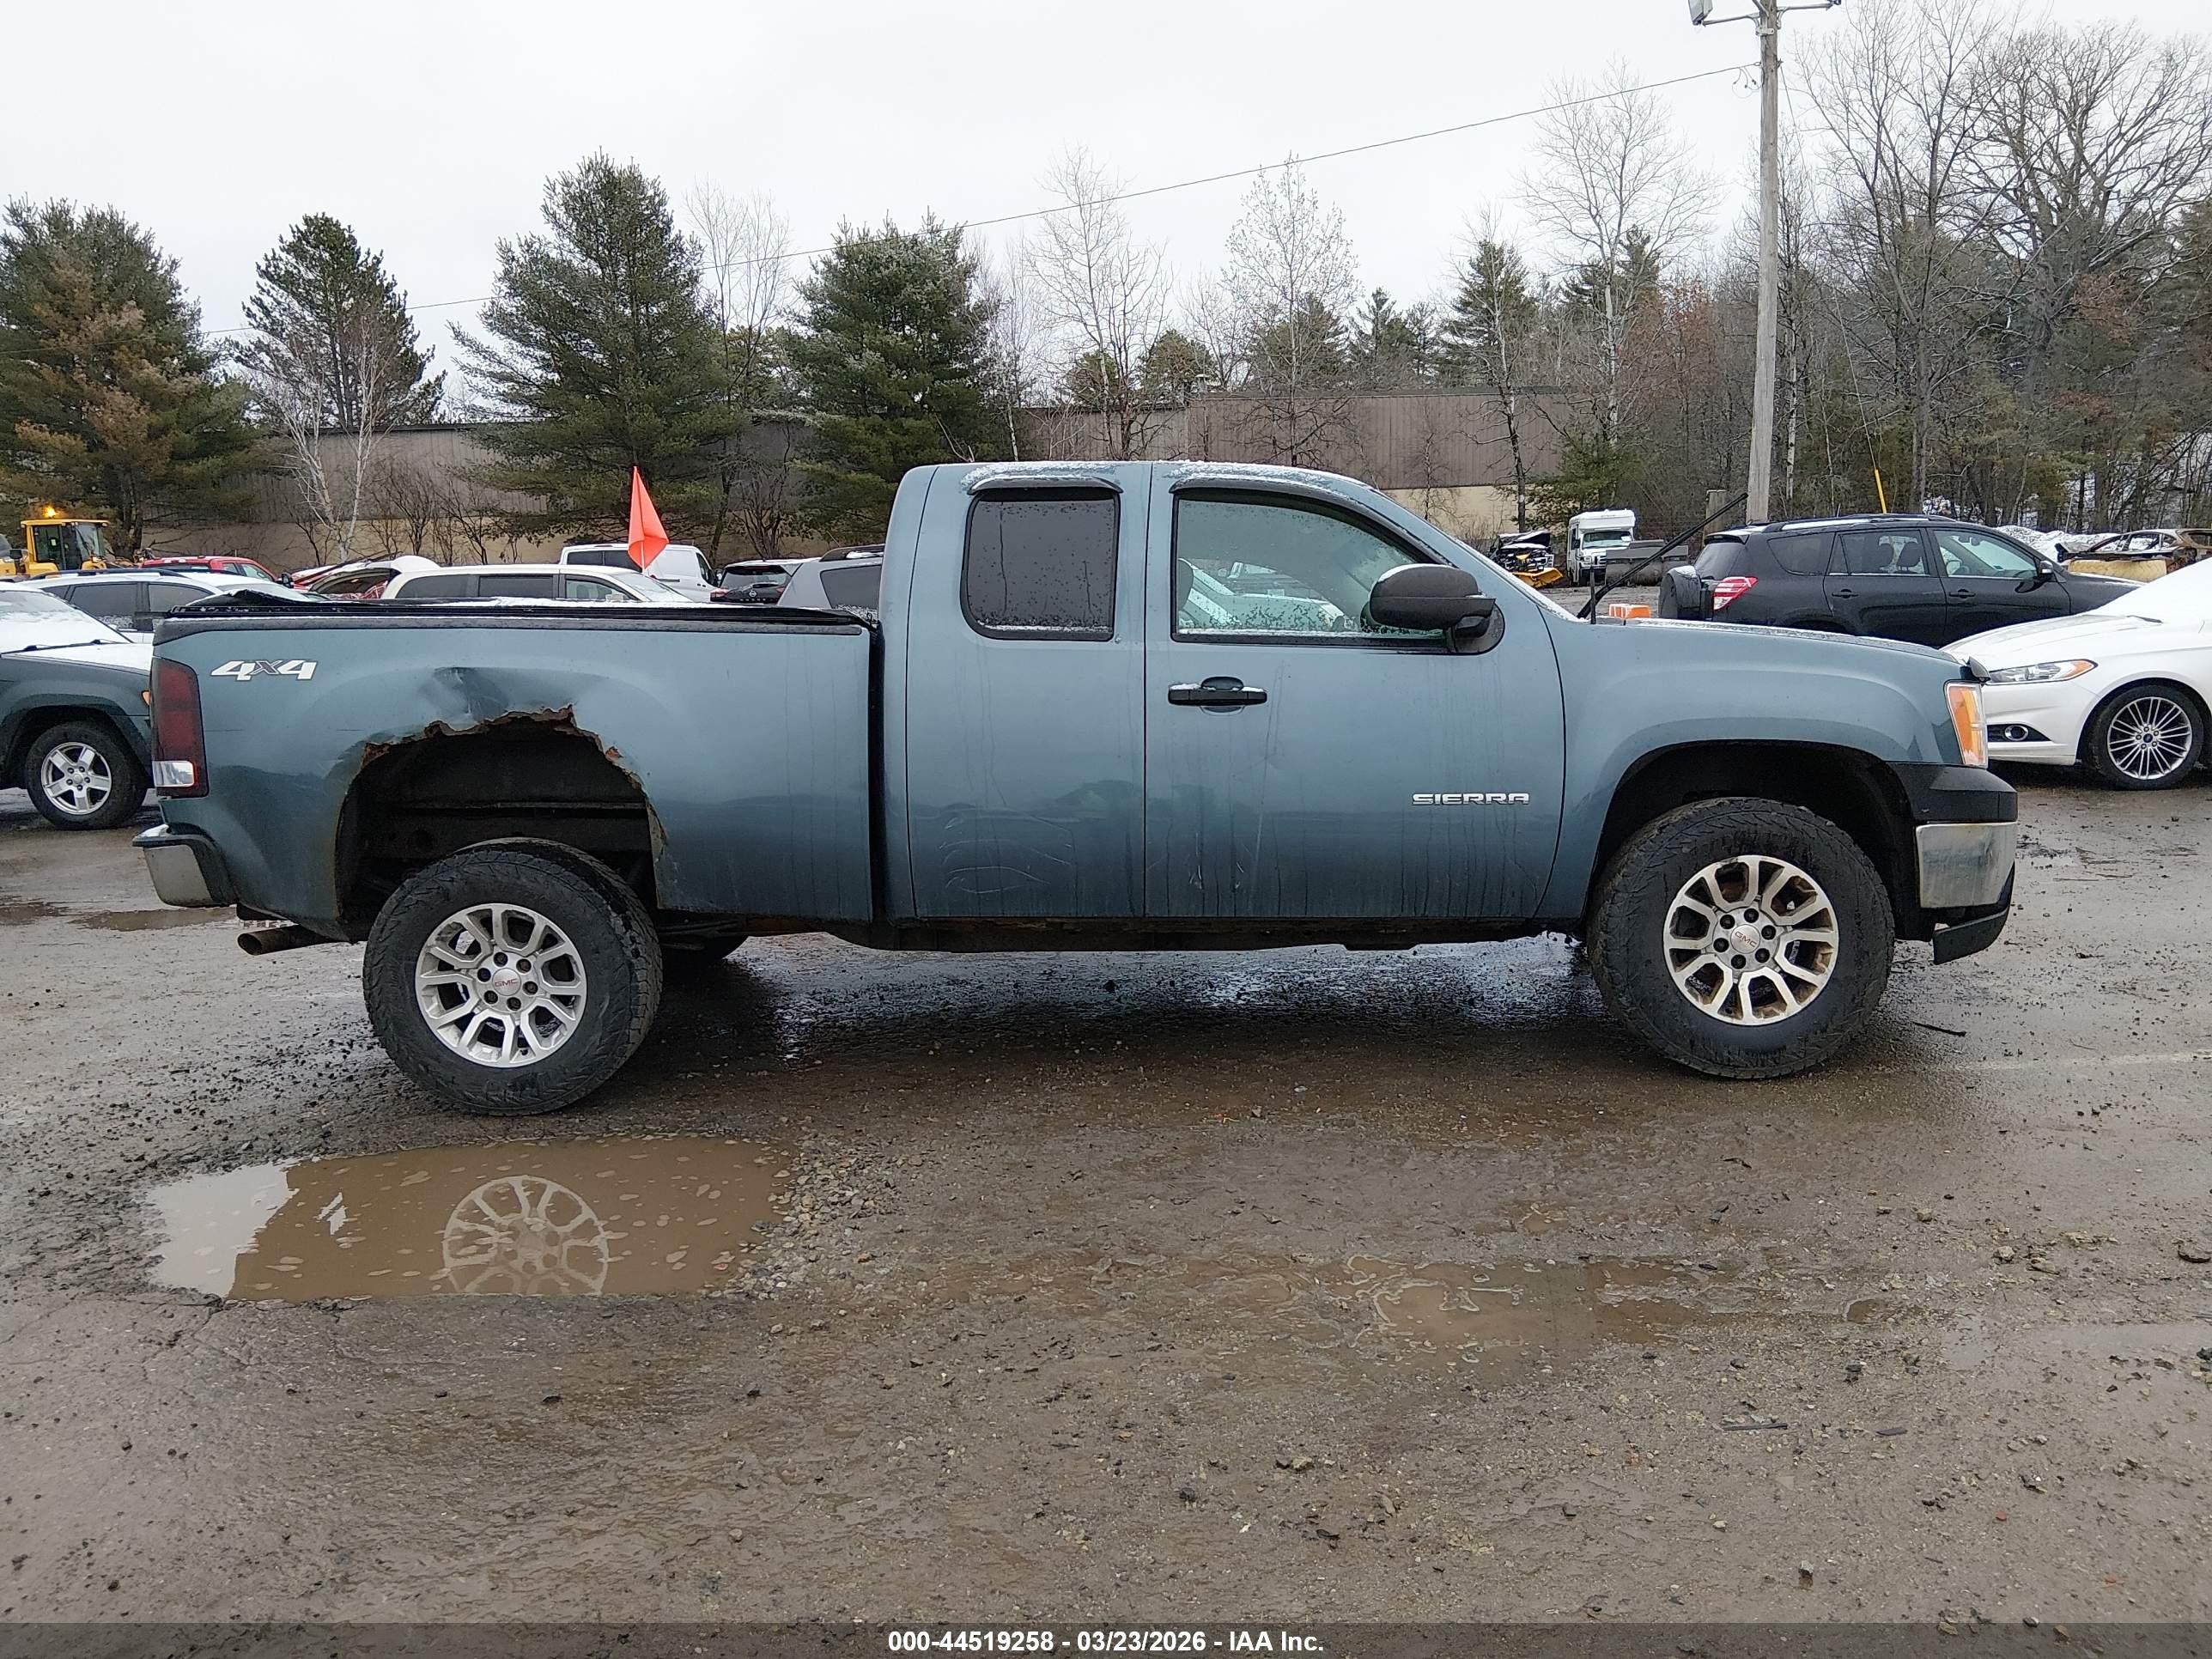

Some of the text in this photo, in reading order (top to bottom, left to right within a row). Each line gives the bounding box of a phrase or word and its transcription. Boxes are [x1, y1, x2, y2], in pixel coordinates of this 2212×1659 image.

[1412, 793, 1530, 805] SIERRA
[1735, 930, 1758, 948] GMC
[494, 977, 518, 988] GMC
